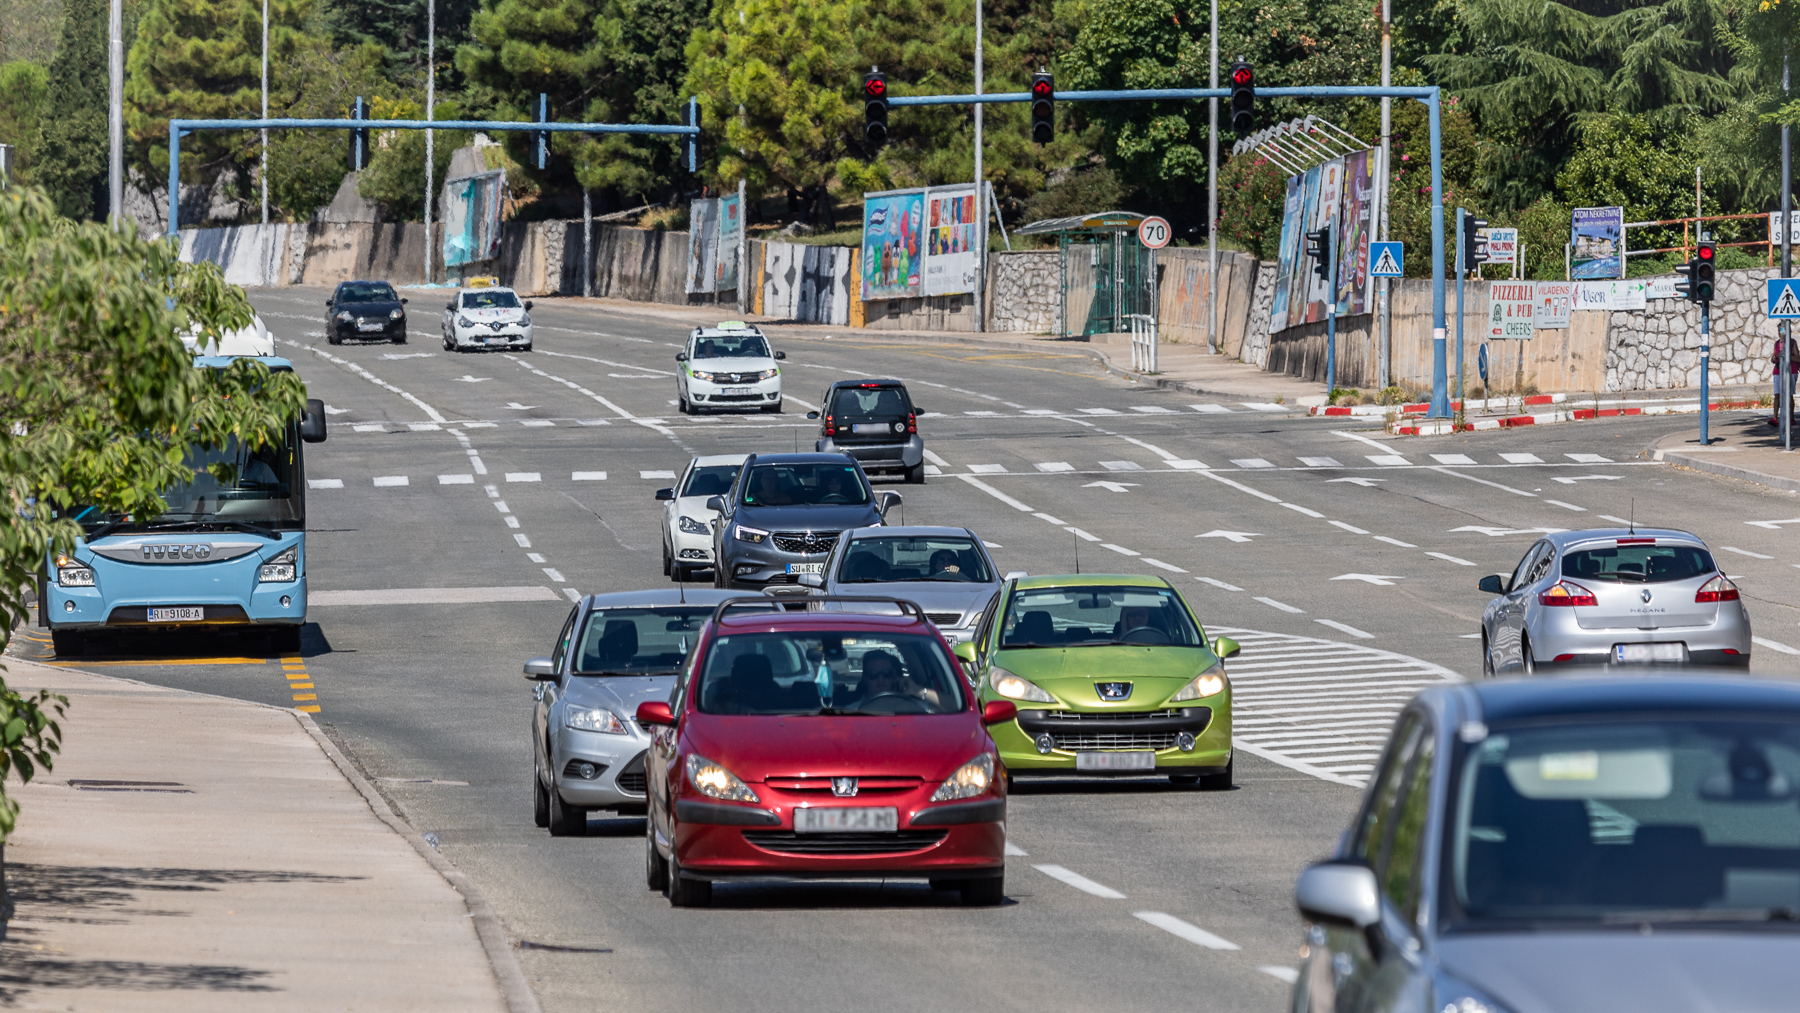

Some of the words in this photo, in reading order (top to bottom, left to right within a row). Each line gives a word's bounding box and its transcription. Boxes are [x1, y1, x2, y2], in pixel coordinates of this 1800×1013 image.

[1574, 210, 1589, 218] ATOM
[1590, 208, 1620, 218] NEKRETNINE
[1146, 225, 1165, 240] 70
[1492, 285, 1533, 301] PIZZERIA
[1538, 286, 1570, 296] VILADENS
[1507, 304, 1512, 317] &
[1517, 304, 1532, 318] PUB
[1506, 322, 1532, 336] CHEERS
[143, 545, 211, 560] IVECO
[791, 565, 801, 573] SU
[805, 565, 814, 573] RI
[153, 608, 164, 619] RI
